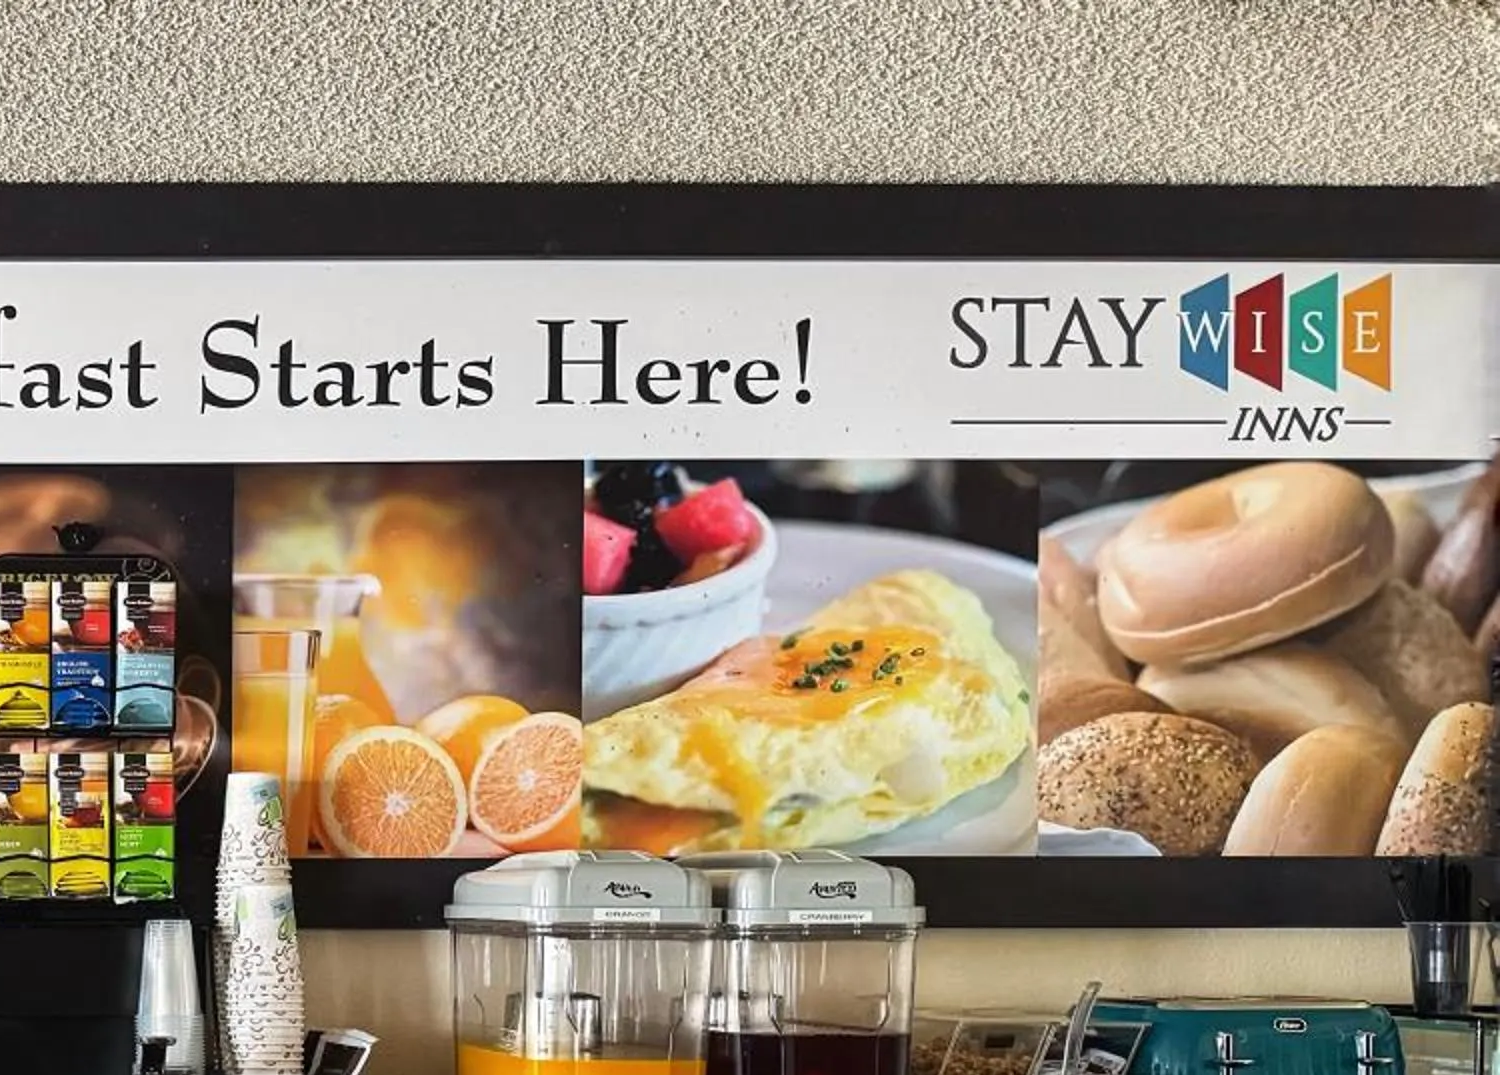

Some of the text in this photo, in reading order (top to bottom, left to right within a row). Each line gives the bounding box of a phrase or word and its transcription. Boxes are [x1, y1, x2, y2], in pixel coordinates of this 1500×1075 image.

[201, 315, 493, 414] Starts
[536, 318, 811, 404] Here!
[950, 297, 1381, 369] STAY WISE
[1228, 407, 1345, 441] INNS
